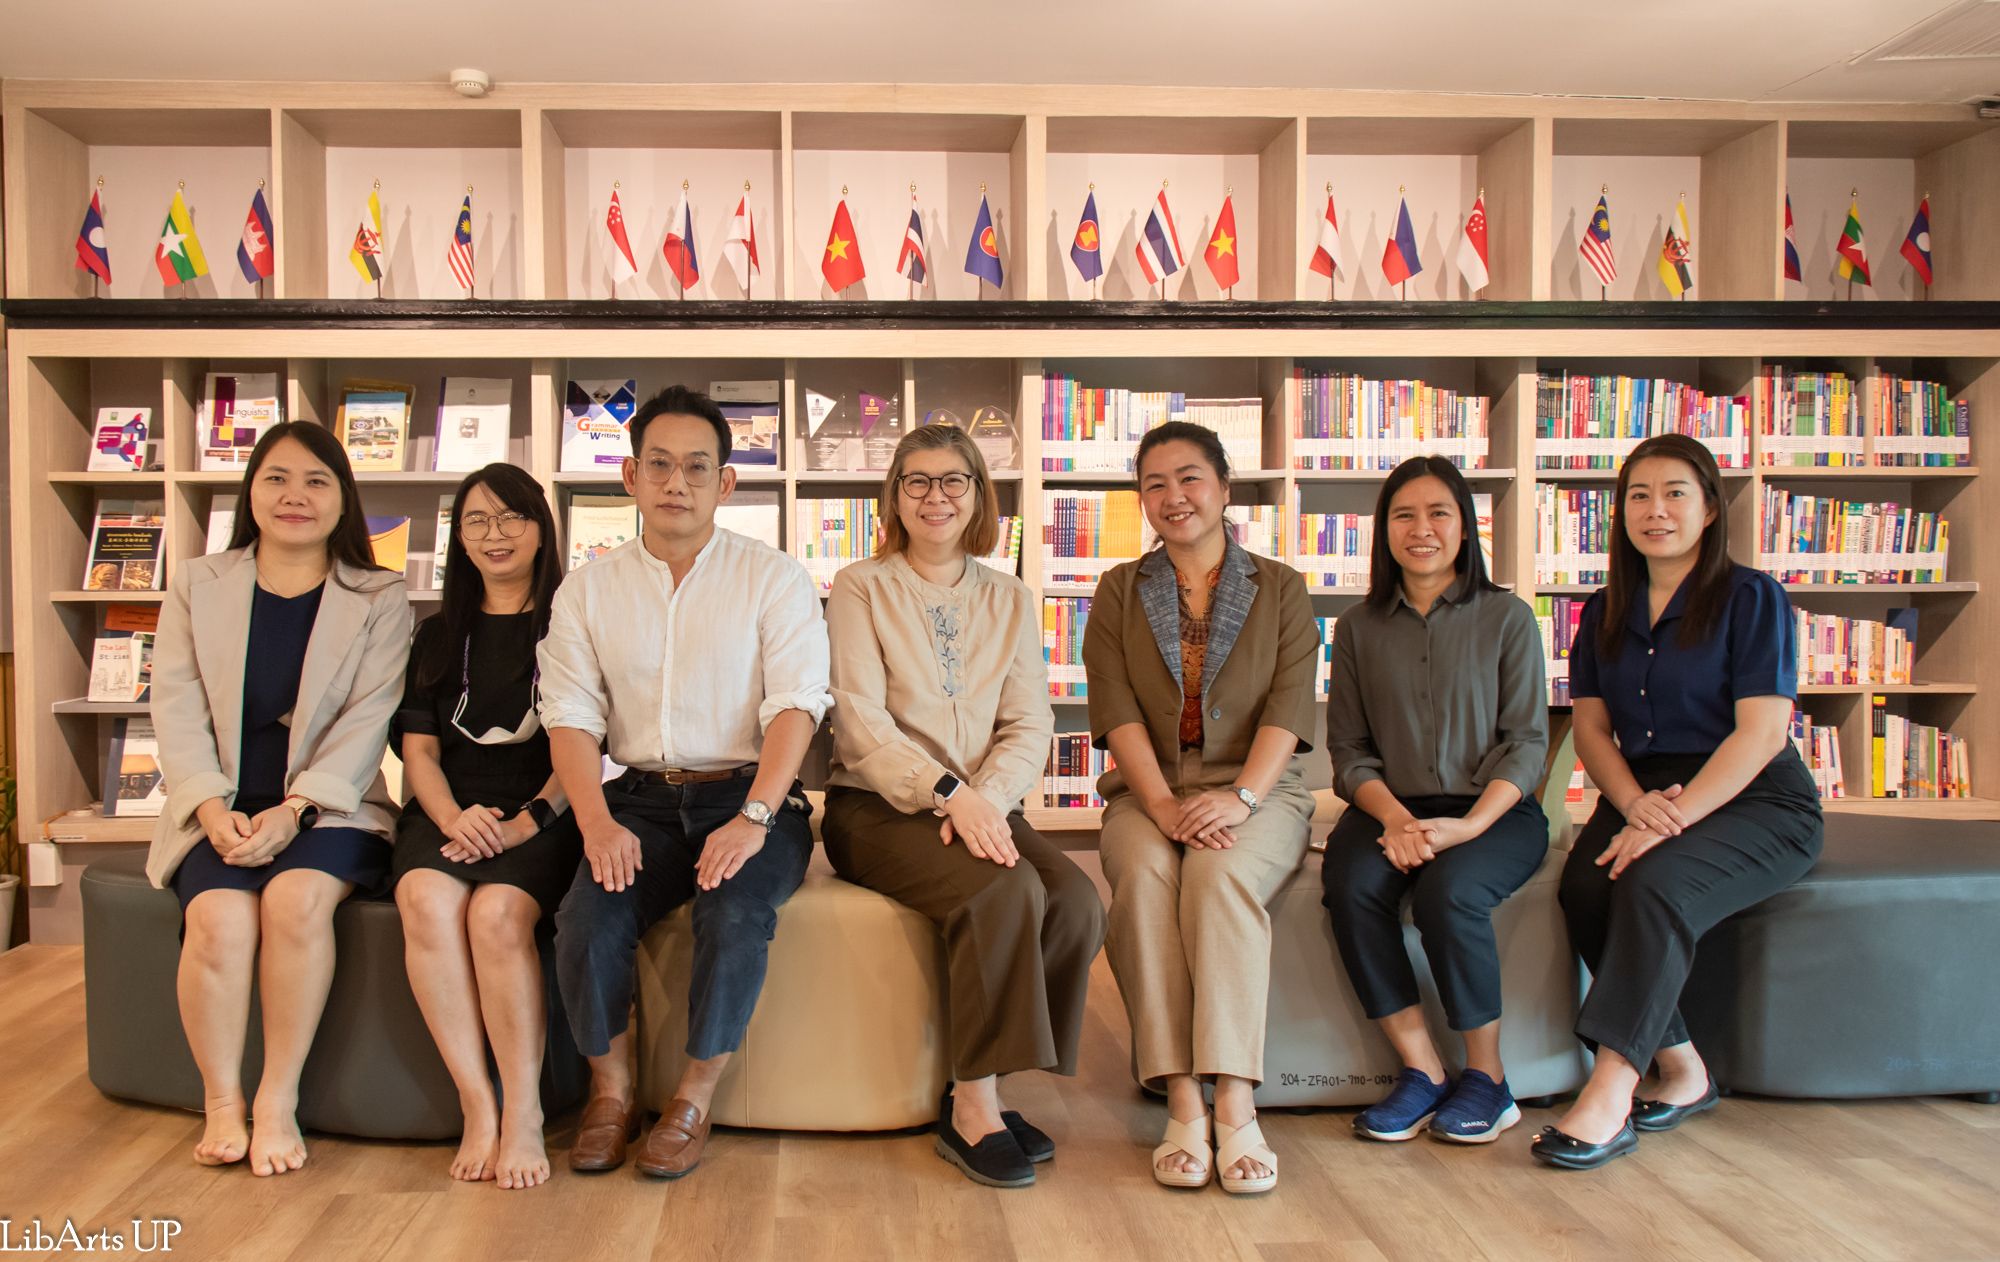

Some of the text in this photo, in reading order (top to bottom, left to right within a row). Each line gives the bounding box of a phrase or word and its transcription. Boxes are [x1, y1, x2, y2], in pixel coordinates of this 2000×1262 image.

[225, 402, 269, 418] Linguistics
[577, 418, 618, 431] Grammar
[1960, 406, 1968, 432] Oxford
[590, 432, 620, 440] Writing
